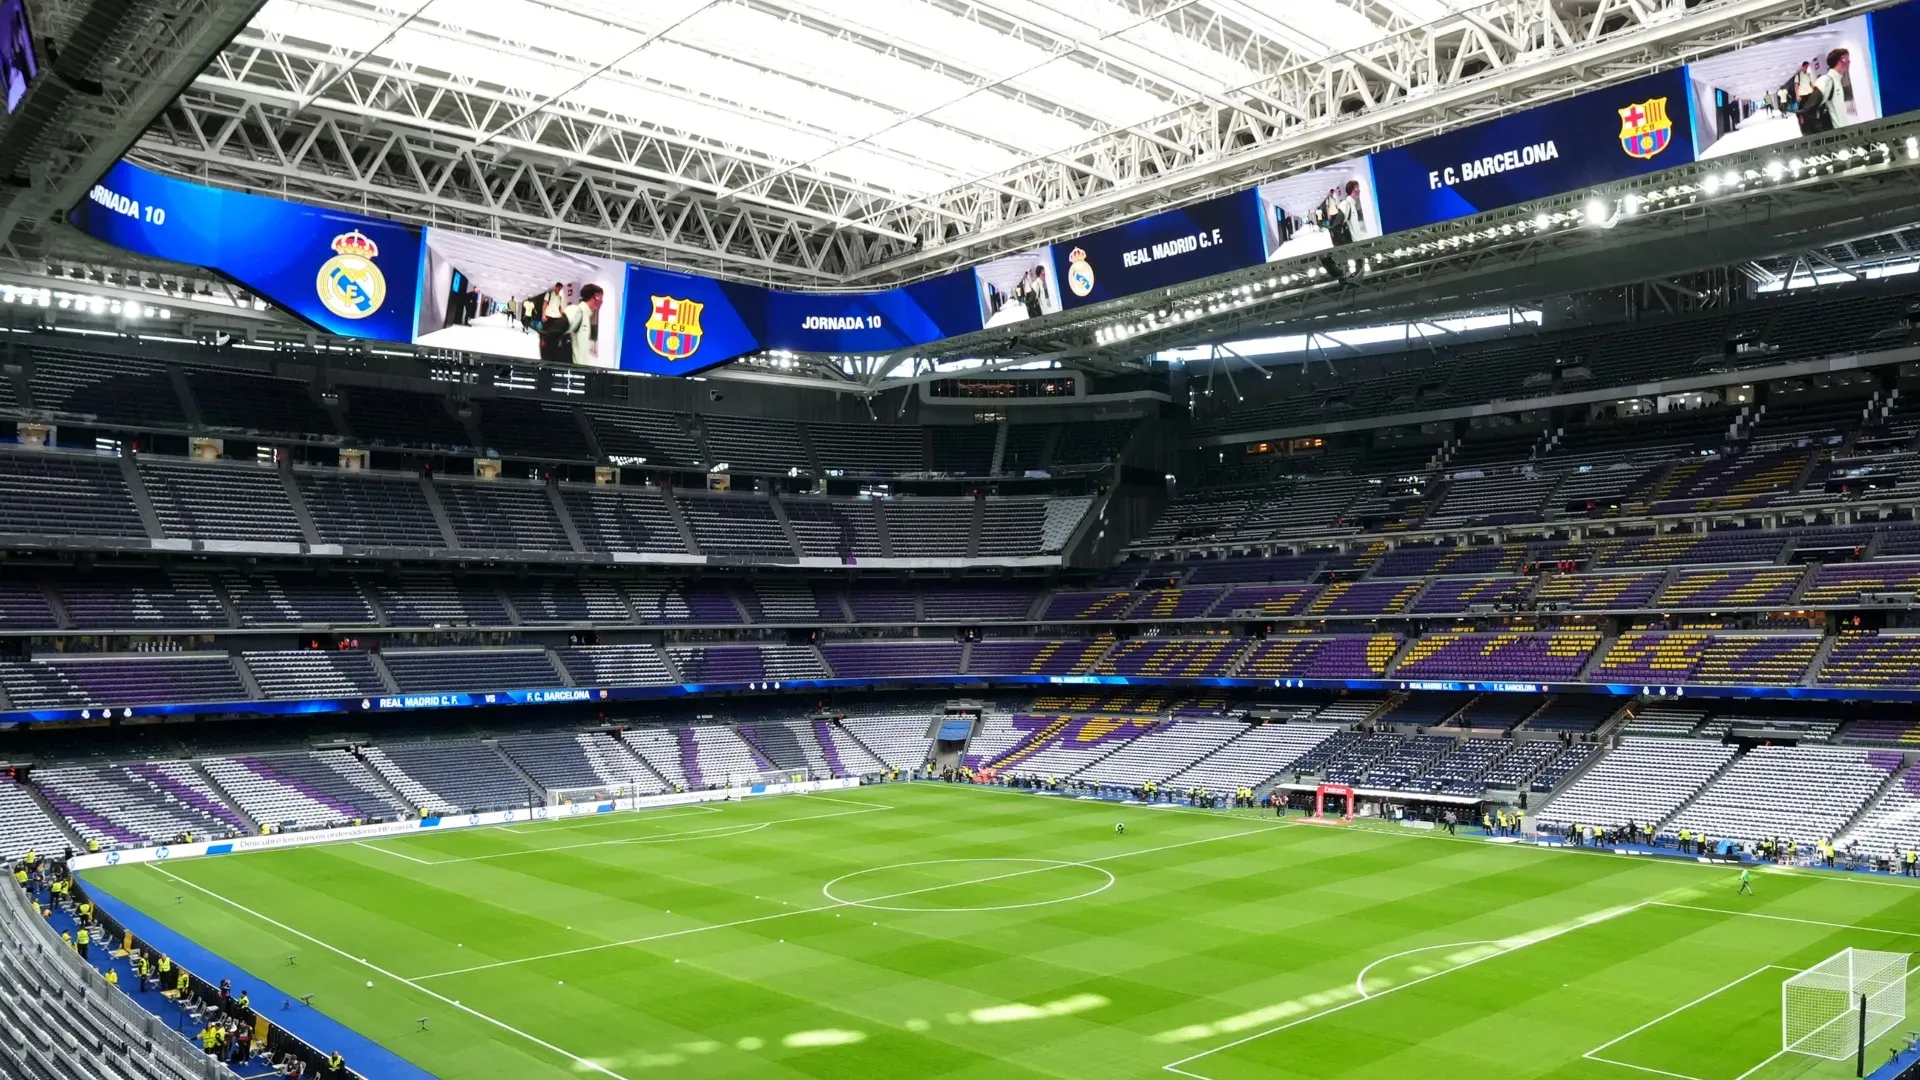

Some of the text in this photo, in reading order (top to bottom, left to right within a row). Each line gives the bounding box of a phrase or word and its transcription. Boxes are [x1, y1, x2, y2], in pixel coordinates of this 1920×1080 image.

[1635, 123, 1655, 133] FCB
[1429, 140, 1559, 190] F. C. BARCELONA
[145, 205, 166, 226] 10
[1123, 228, 1223, 268] REAL MADRID C. F.
[663, 322, 685, 333] FCB
[801, 315, 882, 331] JORNADA 10
[380, 690, 590, 708] REAL MADRID C. F. VS F. C. BARCELONA
[240, 837, 281, 848] Descubre
[296, 833, 326, 842] nuevos
